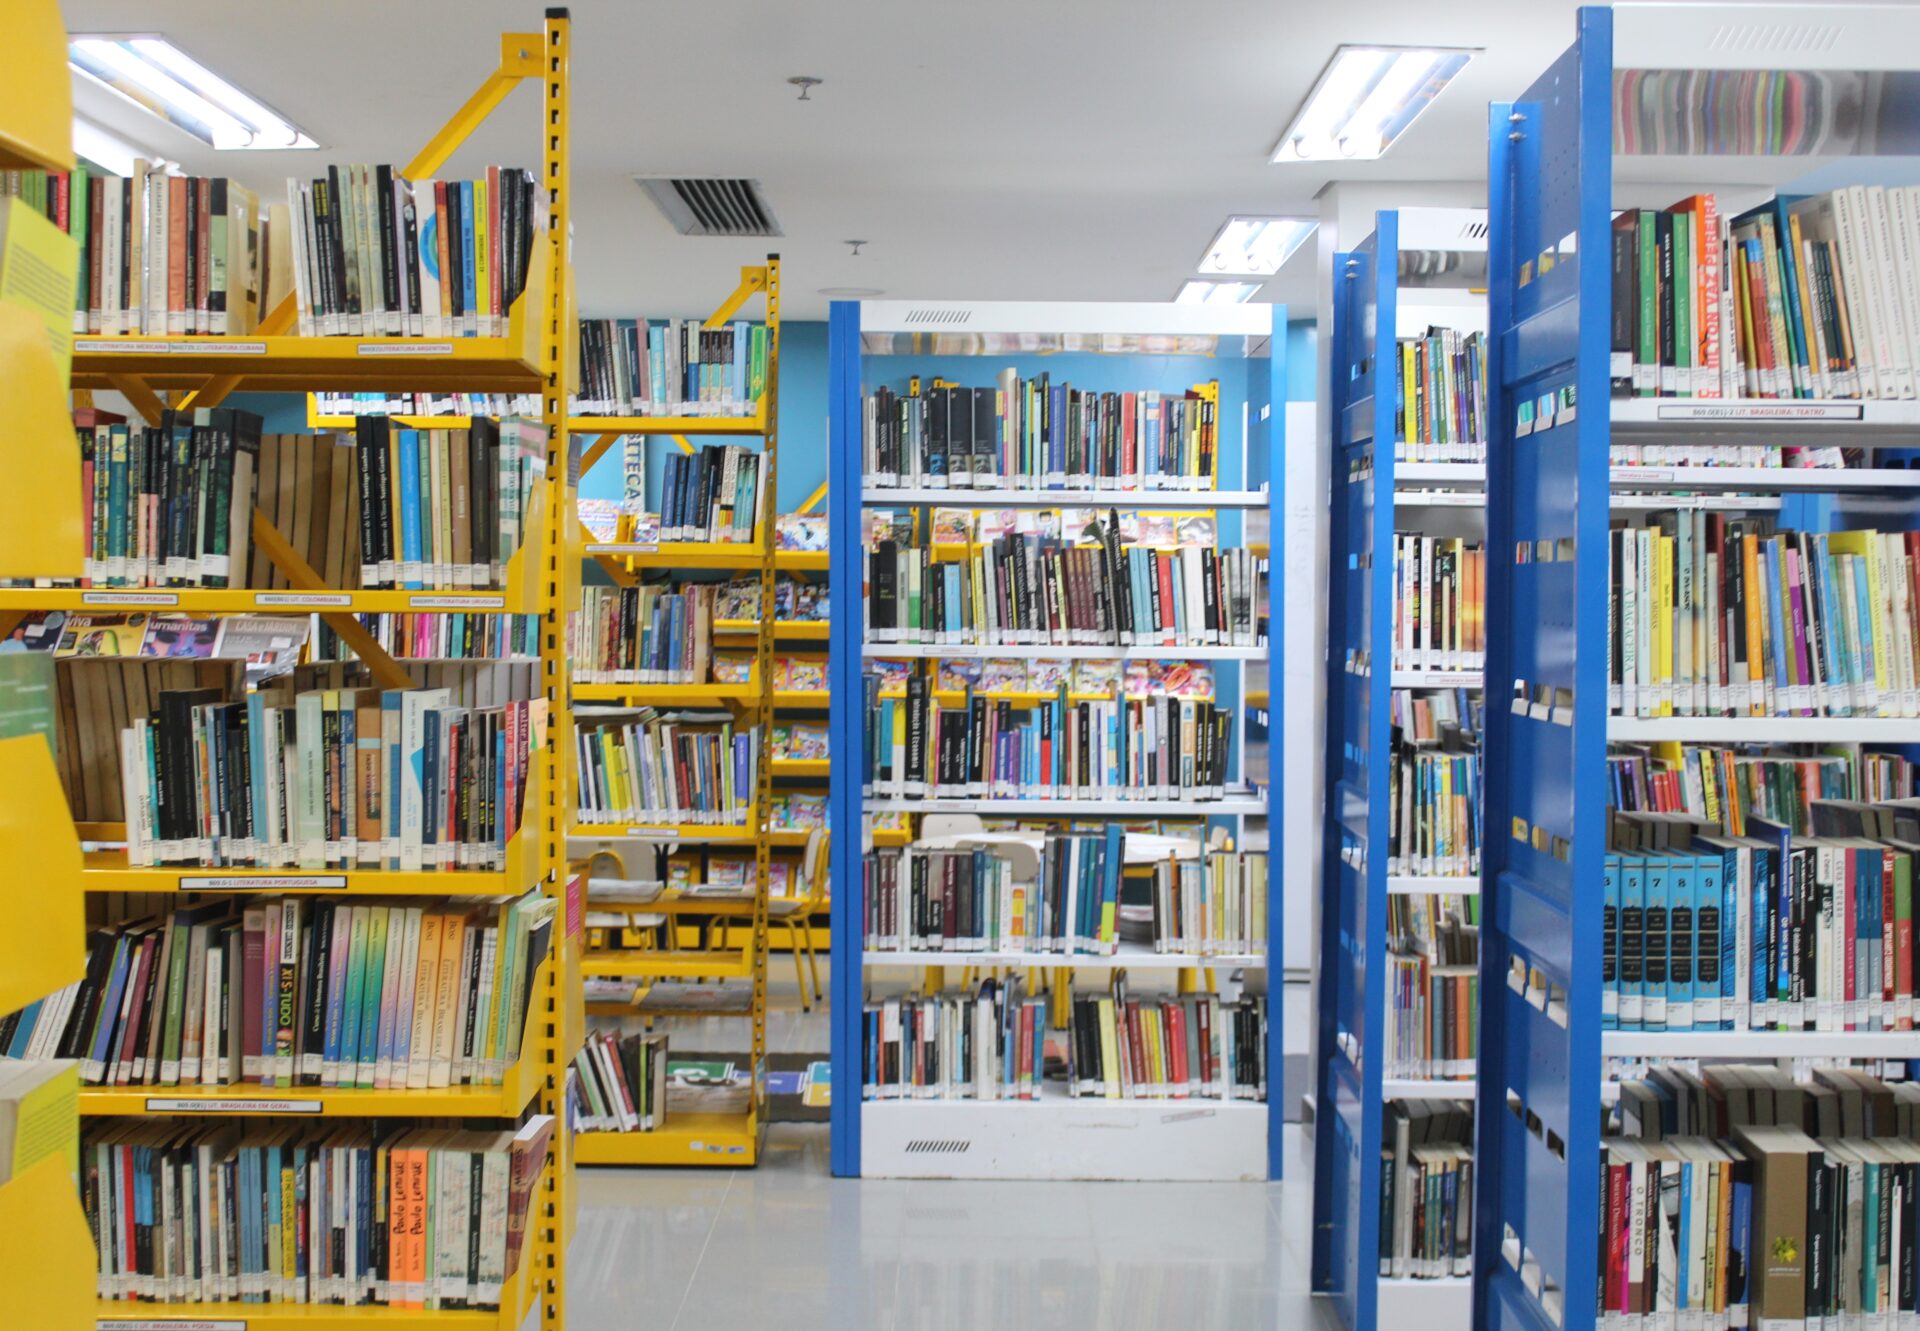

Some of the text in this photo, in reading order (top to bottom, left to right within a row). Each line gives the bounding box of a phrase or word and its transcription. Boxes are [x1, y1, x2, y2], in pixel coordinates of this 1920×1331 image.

[155, 217, 163, 234] ALEJO
[1702, 193, 1721, 304] VAZ PEREIRA
[362, 473, 371, 498] Santiago
[911, 699, 920, 730] Introdução
[911, 736, 920, 768] Economia
[235, 880, 271, 888] LITERATURA
[274, 880, 318, 888] PORTUGUESA
[1628, 878, 1637, 888] 5
[1652, 878, 1661, 888] 7
[1677, 878, 1686, 888] 8
[1704, 878, 1713, 888] 9
[426, 921, 435, 941] BOSI
[448, 920, 457, 940] BOSI
[280, 968, 294, 1024] XIS-TUDO
[413, 959, 428, 1055] LITERATURA BRASILEIRA
[435, 959, 450, 1054] LITERATURA BRASILEIRA
[514, 1148, 523, 1185] MATOS
[393, 1162, 406, 1234] Paulo Leminski
[410, 1162, 424, 1235] Paulo Leminski
[1634, 1186, 1645, 1256] O TRONCO
